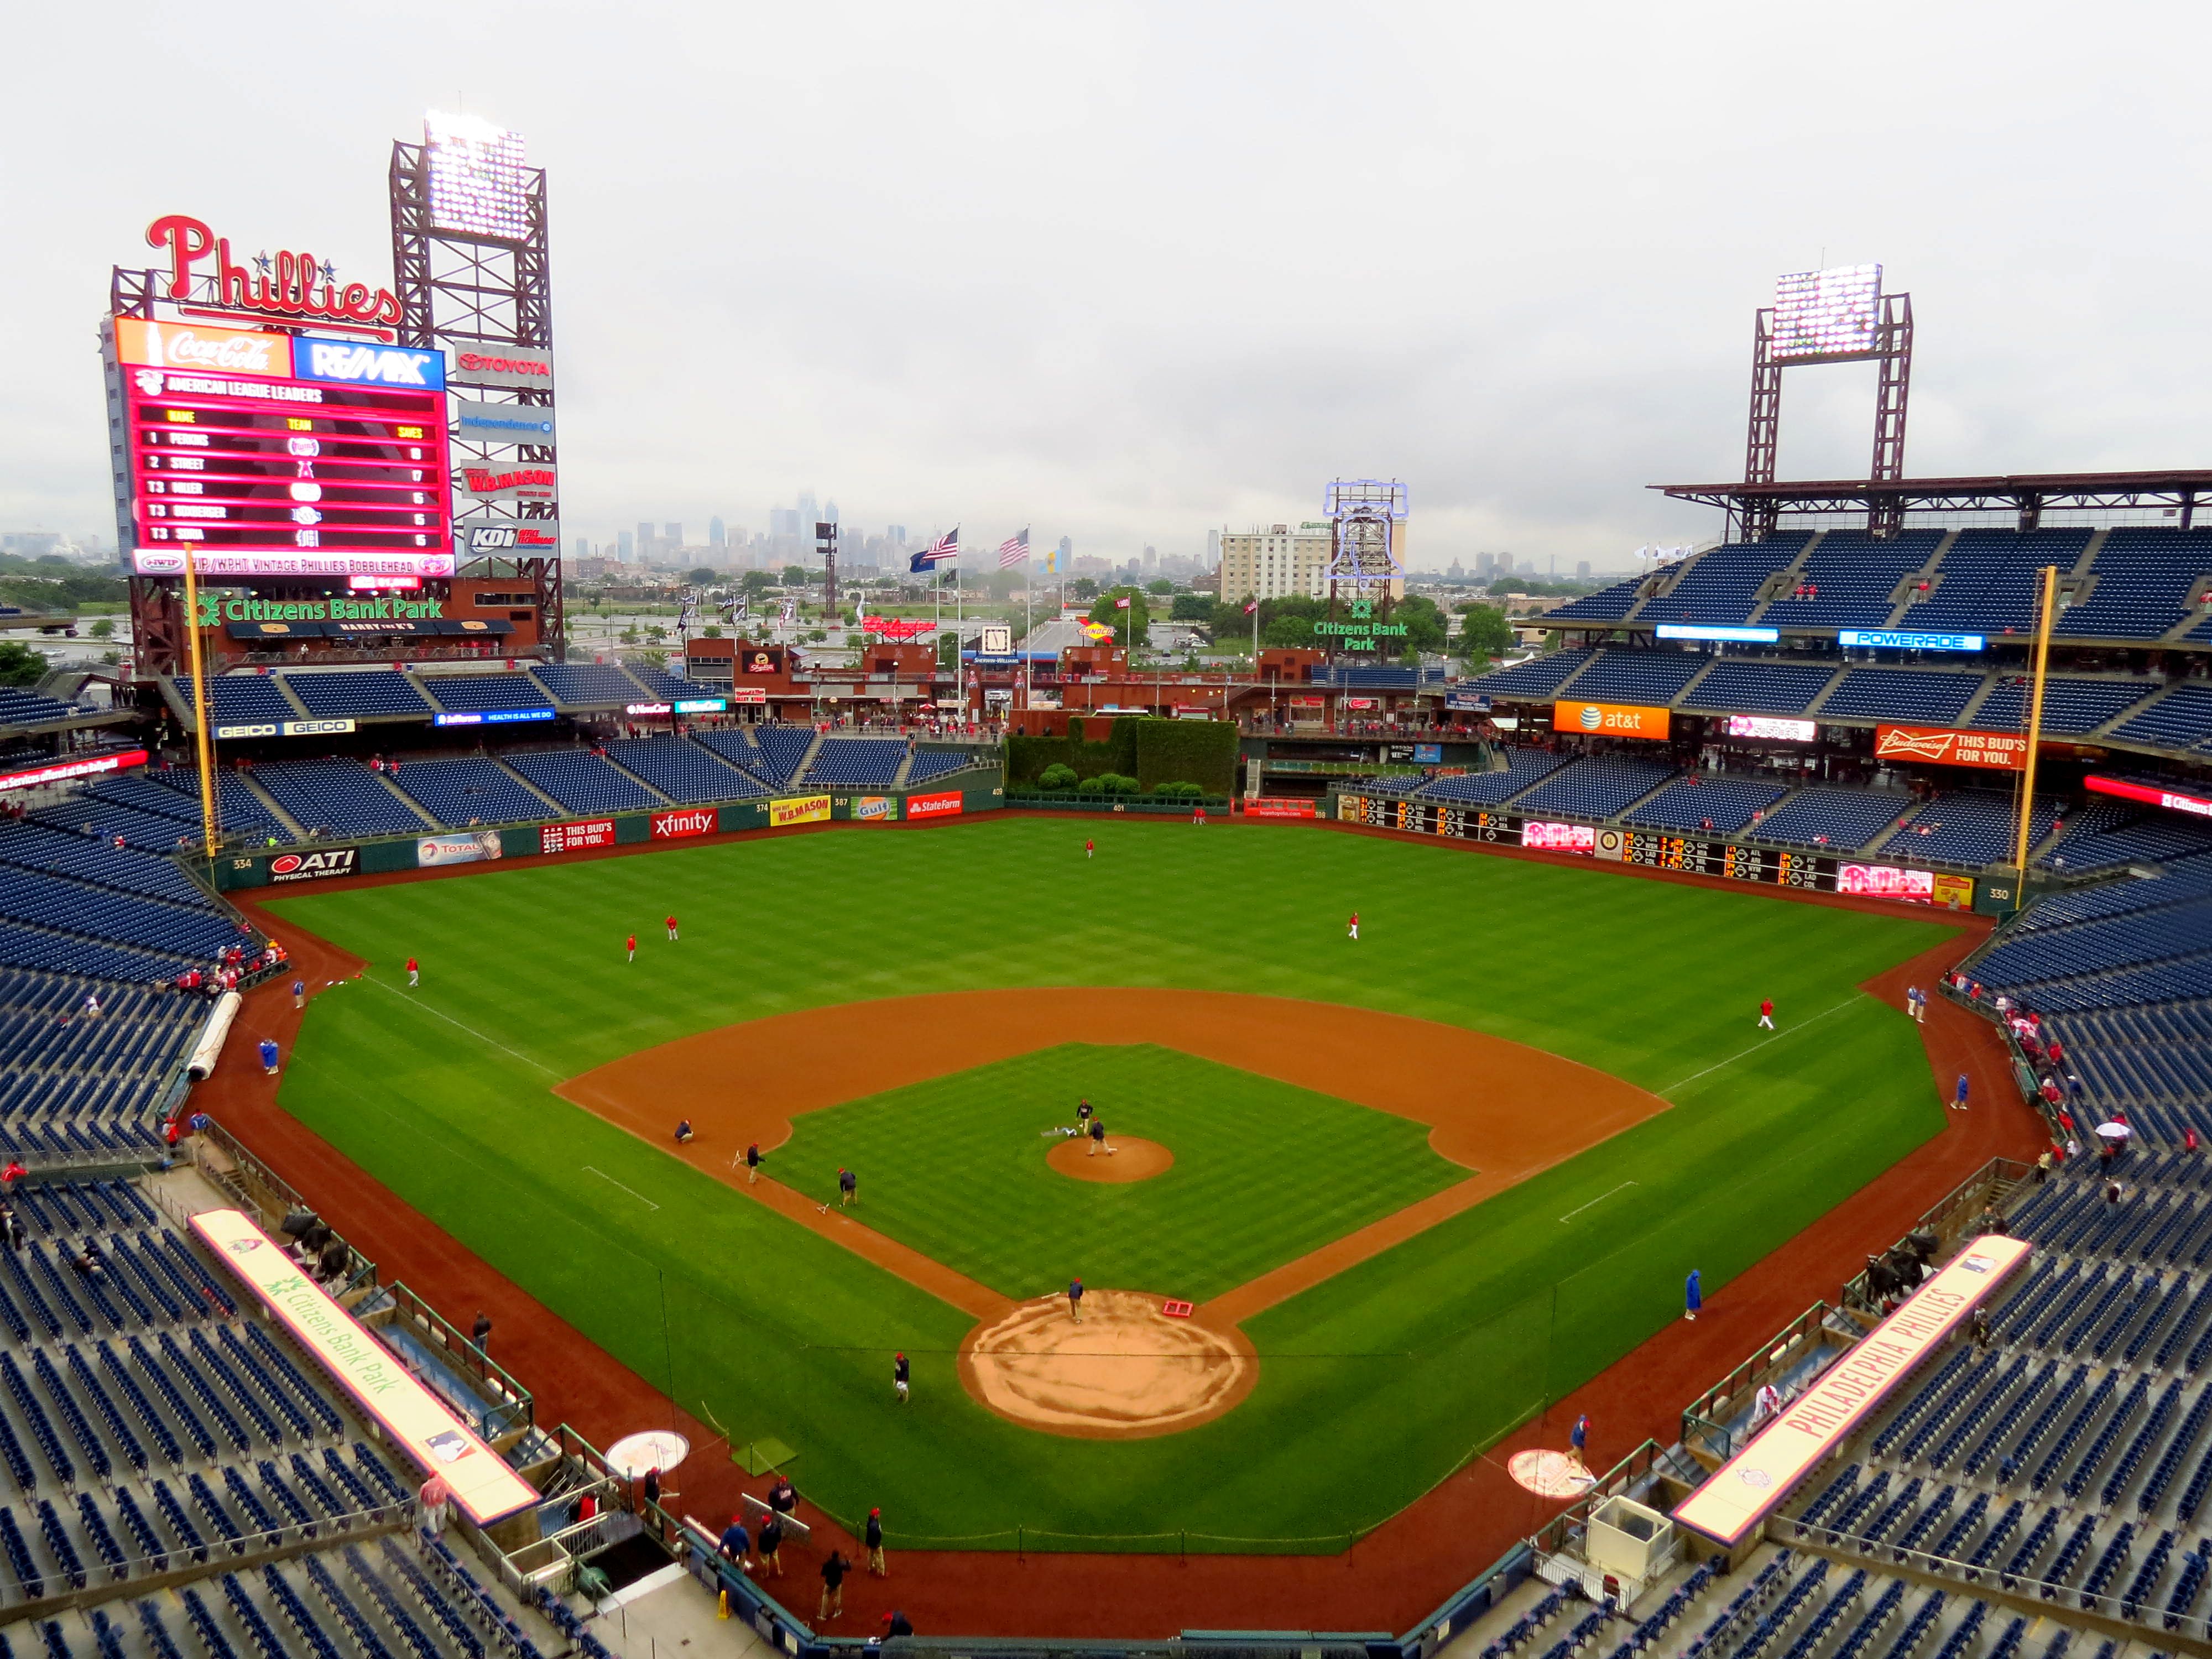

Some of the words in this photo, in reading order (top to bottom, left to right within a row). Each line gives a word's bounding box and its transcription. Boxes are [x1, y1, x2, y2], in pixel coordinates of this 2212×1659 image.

[147, 215, 403, 325] Phillies
[168, 331, 273, 371] Coca-Cola
[311, 344, 431, 385] RE/MAX
[483, 357, 550, 377] TOYOTA
[167, 377, 227, 395] AMERICAN
[228, 383, 271, 399] LEAGUE
[272, 387, 322, 404] LEADERS
[167, 410, 195, 423] NAME
[286, 418, 312, 431] TEAM
[397, 426, 423, 440] SAVES
[463, 416, 538, 431] Independence
[150, 432, 157, 444] 1
[150, 456, 159, 468] 2
[169, 458, 205, 471] STREET
[147, 481, 165, 493] T3
[148, 504, 166, 517] T3
[150, 528, 168, 540] T3
[253, 559, 297, 572] VINTAGE
[301, 559, 346, 572] PHILLIES
[349, 560, 414, 573] BOBBLEHEAD
[226, 599, 325, 620] Citizens
[330, 598, 389, 619] Bank
[393, 598, 443, 619] Park
[1080, 627, 1113, 635] SUNOCO
[1314, 622, 1370, 635] Citizens
[1373, 622, 1408, 635] Bank
[1344, 637, 1376, 651] Park
[1605, 712, 1641, 729] at&t
[218, 724, 276, 738] GEICO
[293, 721, 347, 733] GEICO
[1754, 725, 1799, 739] 5:58:36
[1880, 734, 1950, 750] Budweiser
[1957, 735, 1985, 748] THIS
[1988, 738, 2026, 752] BUD'S
[1956, 749, 1979, 761] FOR
[1983, 751, 2011, 764] YOU.
[9, 775, 40, 787] Services
[40, 768, 66, 781] offered
[76, 764, 88, 775] the
[757, 804, 768, 812] 374
[859, 801, 888, 816] Gulf
[2173, 796, 2208, 814] Citizens
[566, 826, 585, 835] THIS
[587, 822, 612, 833] BUD'S
[656, 814, 712, 836] xfinity
[567, 837, 583, 846] FOR
[586, 834, 604, 844] YOU.
[442, 844, 479, 853] TOTAL
[233, 859, 252, 869] 334
[301, 851, 354, 870] ATI
[274, 872, 312, 881] PHYSICAL
[315, 867, 351, 877] THERAPY
[1840, 865, 1921, 891] Phillies
[1990, 888, 2008, 900] 330
[287, 1293, 334, 1335] Citizens
[327, 1333, 368, 1366] Bank
[361, 1361, 399, 1393] Park
[1786, 1339, 1912, 1438] PHILADELPHIA
[1889, 1288, 1964, 1340] PHILLIES
